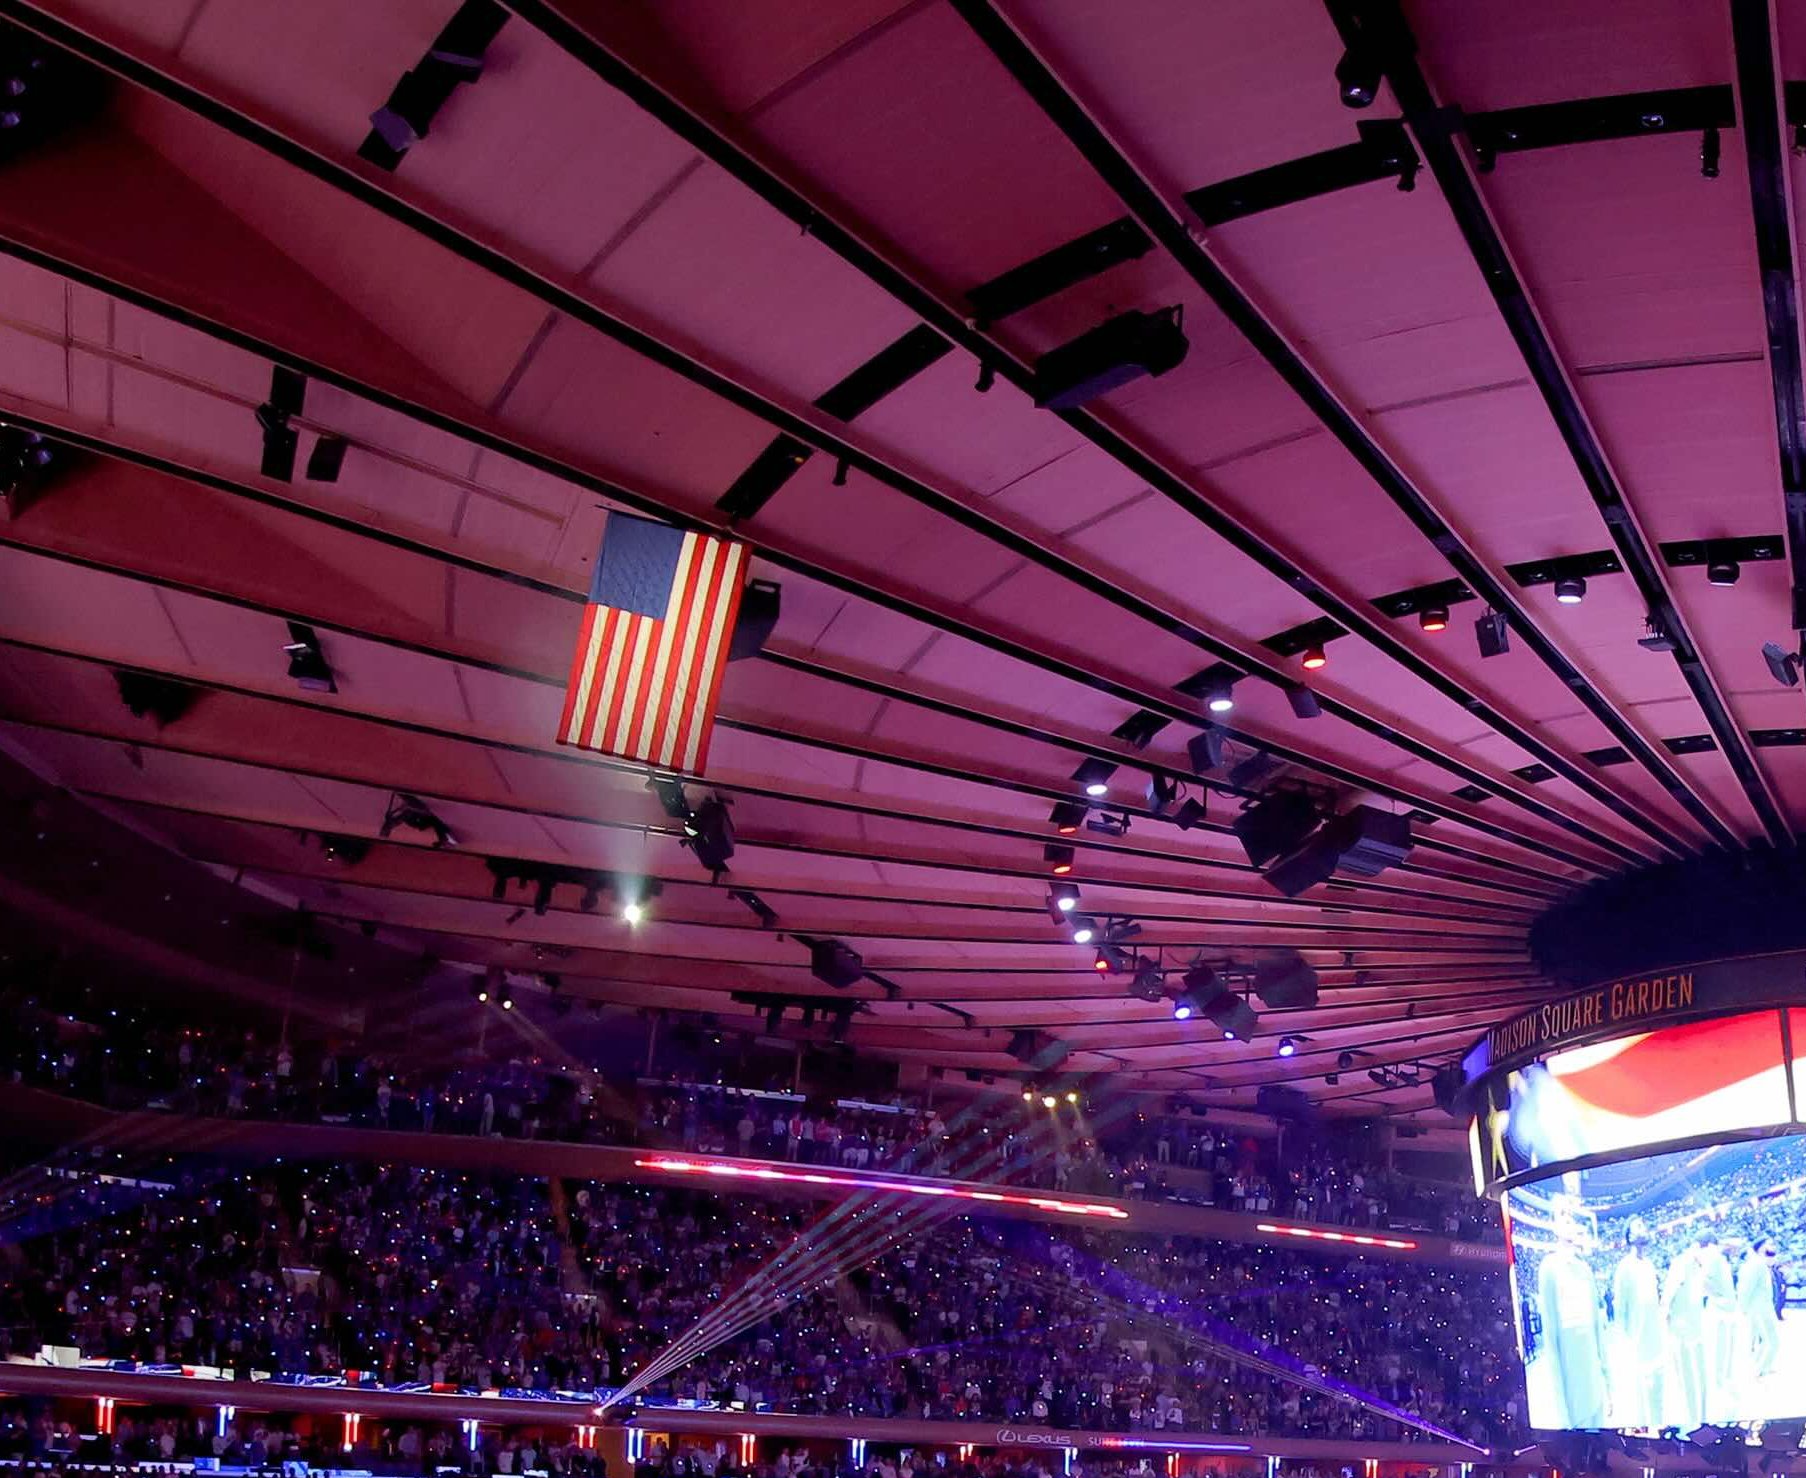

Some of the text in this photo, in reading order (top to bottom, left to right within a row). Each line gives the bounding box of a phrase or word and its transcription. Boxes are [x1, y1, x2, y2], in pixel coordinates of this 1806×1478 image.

[1541, 991, 1605, 1041] SQUARE
[1611, 973, 1694, 1020] GARDEN
[1017, 1434, 1072, 1445] LEXUS
